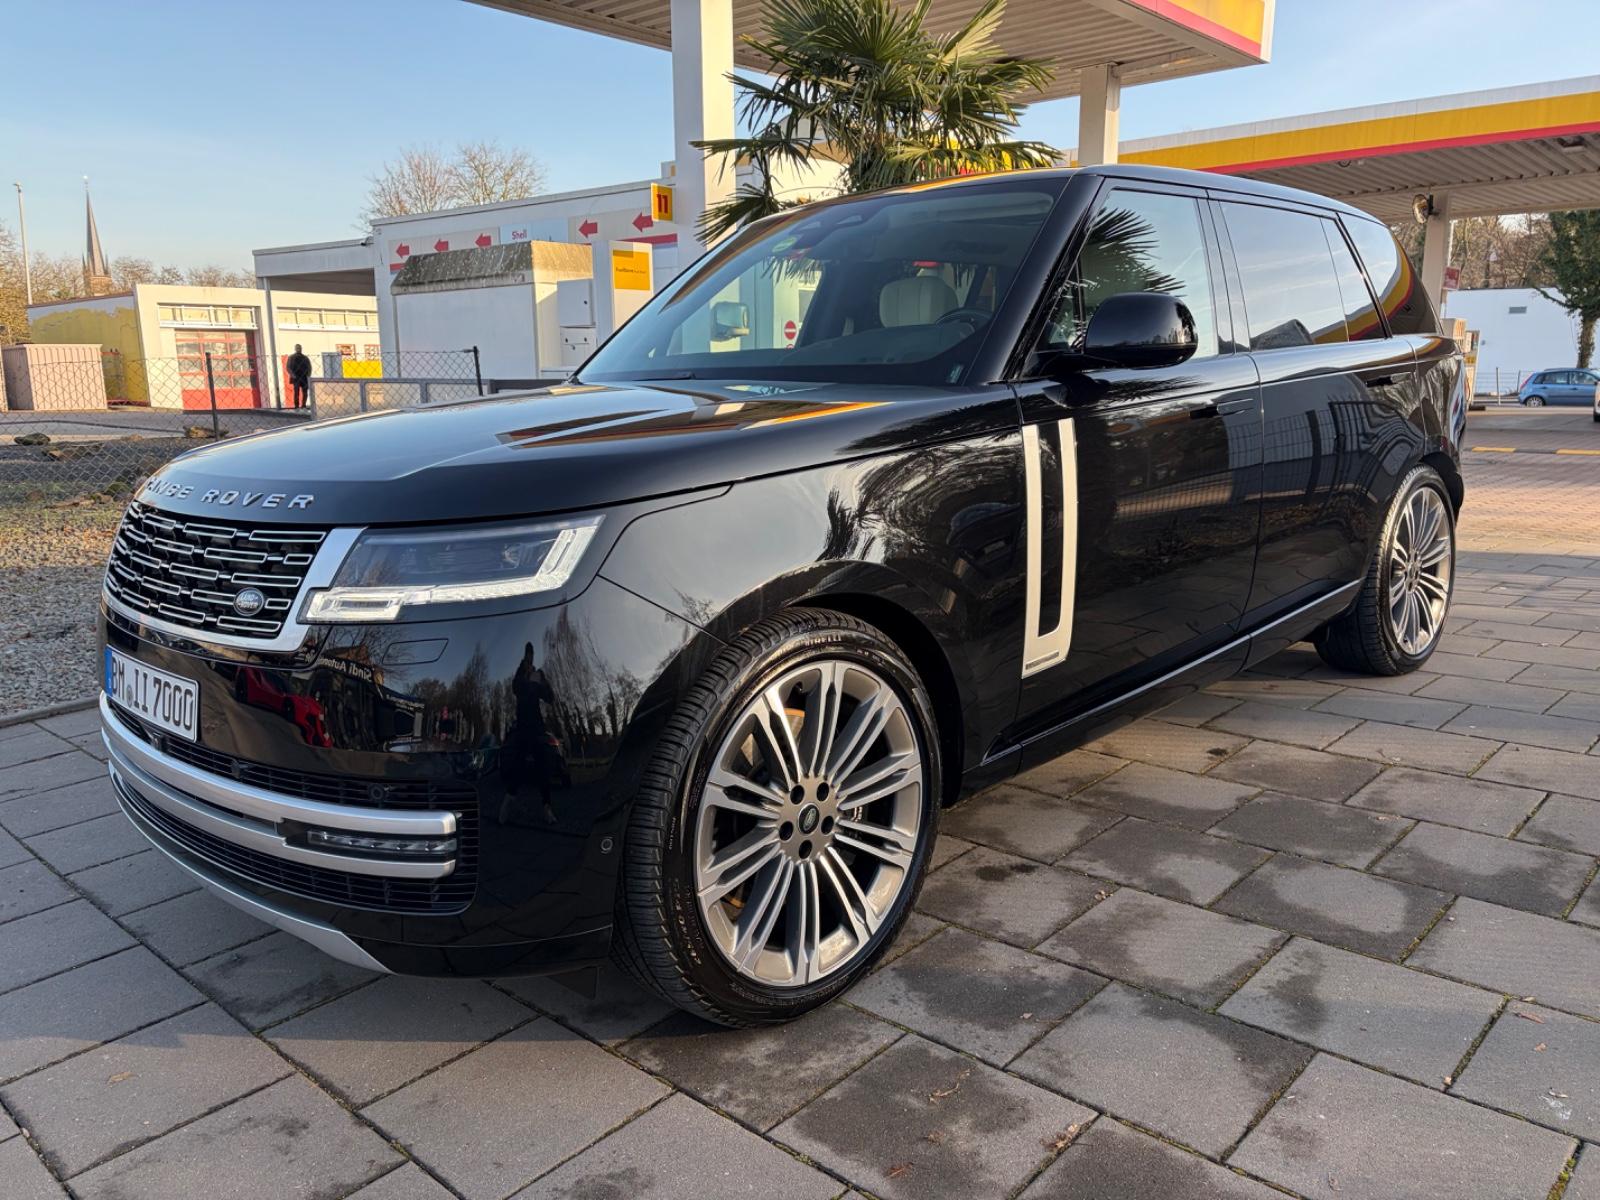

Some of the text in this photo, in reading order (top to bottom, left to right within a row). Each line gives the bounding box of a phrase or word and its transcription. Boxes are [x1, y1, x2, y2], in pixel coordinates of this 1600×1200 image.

[656, 193, 669, 214] 11
[511, 229, 528, 240] Shell
[200, 488, 315, 510] ROVER
[112, 656, 125, 701] BM
[153, 676, 194, 731] 7000
